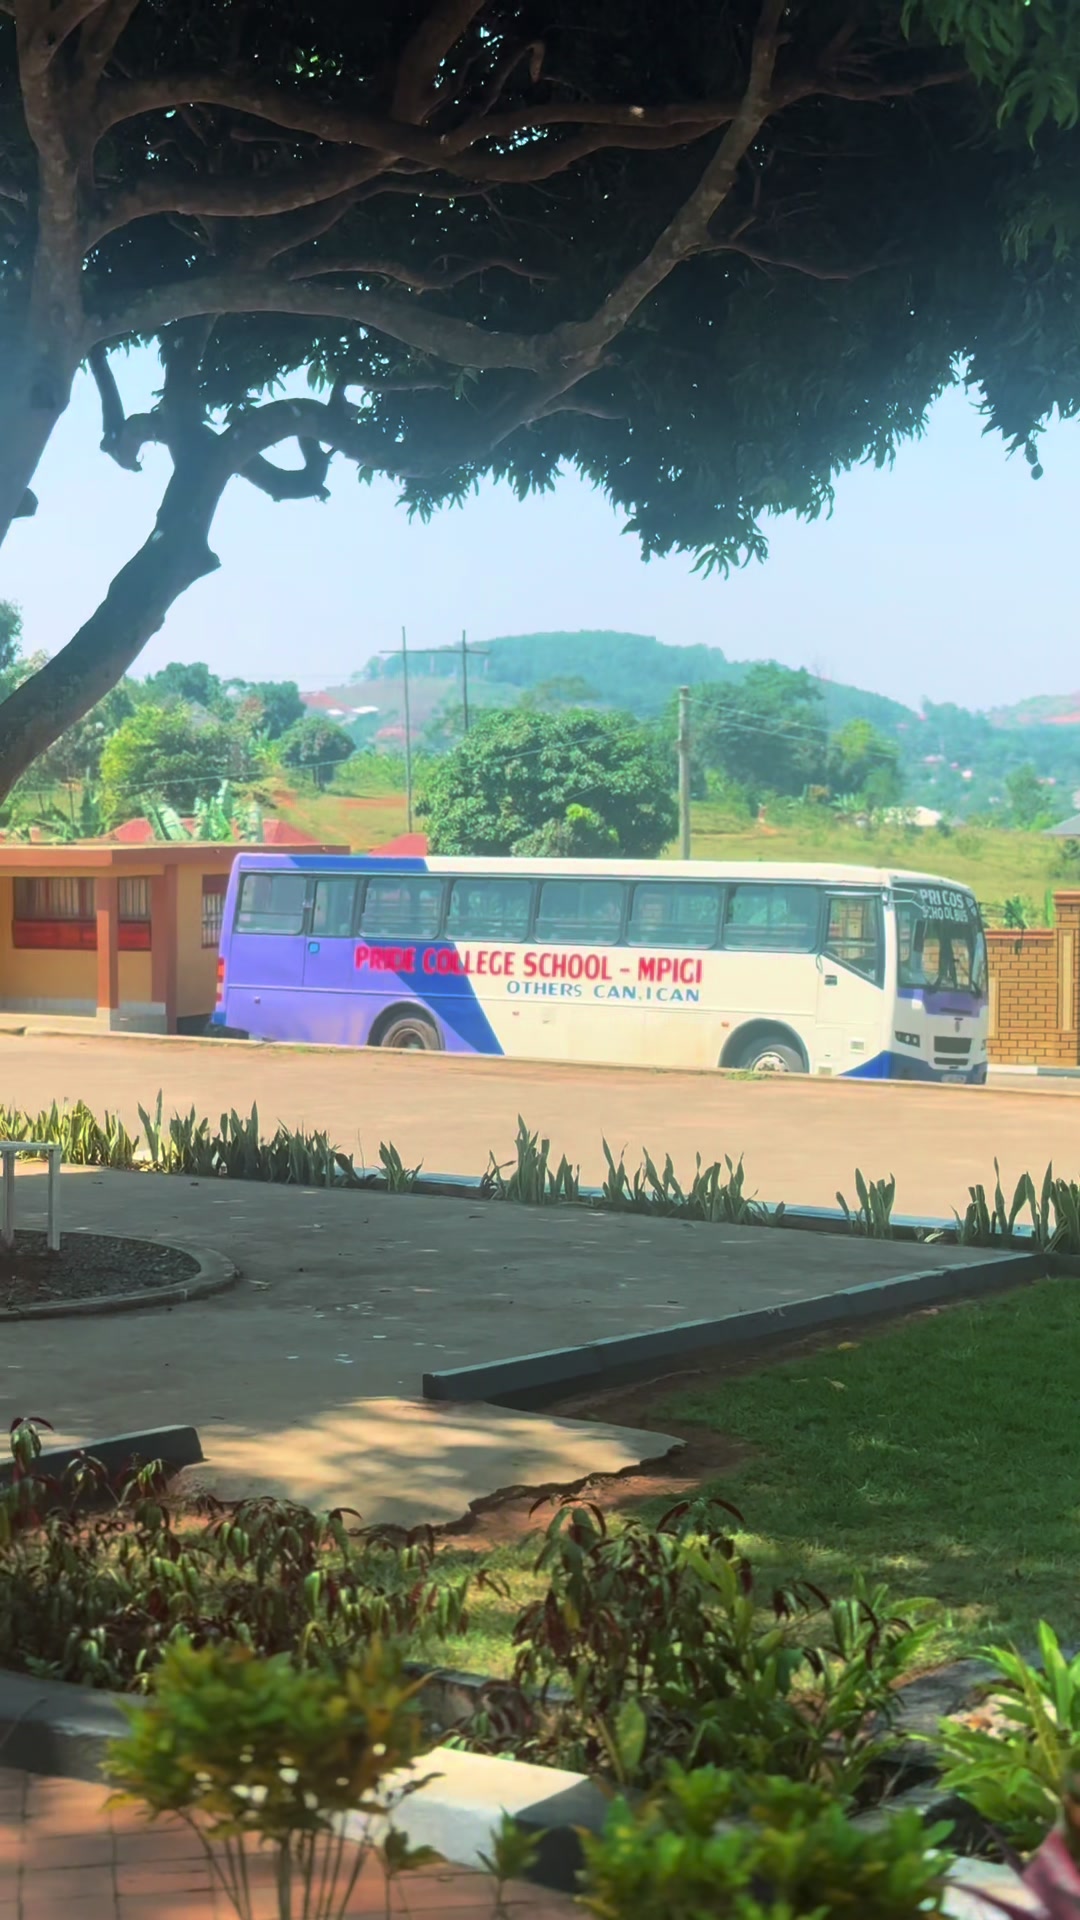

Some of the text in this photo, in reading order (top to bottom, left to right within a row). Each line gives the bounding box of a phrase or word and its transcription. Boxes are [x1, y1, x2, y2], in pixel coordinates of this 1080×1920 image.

[422, 947, 515, 976] COLLEGE
[523, 952, 612, 981] SCHOOL
[637, 957, 702, 984] MPIGI
[507, 980, 582, 997] OTHERS
